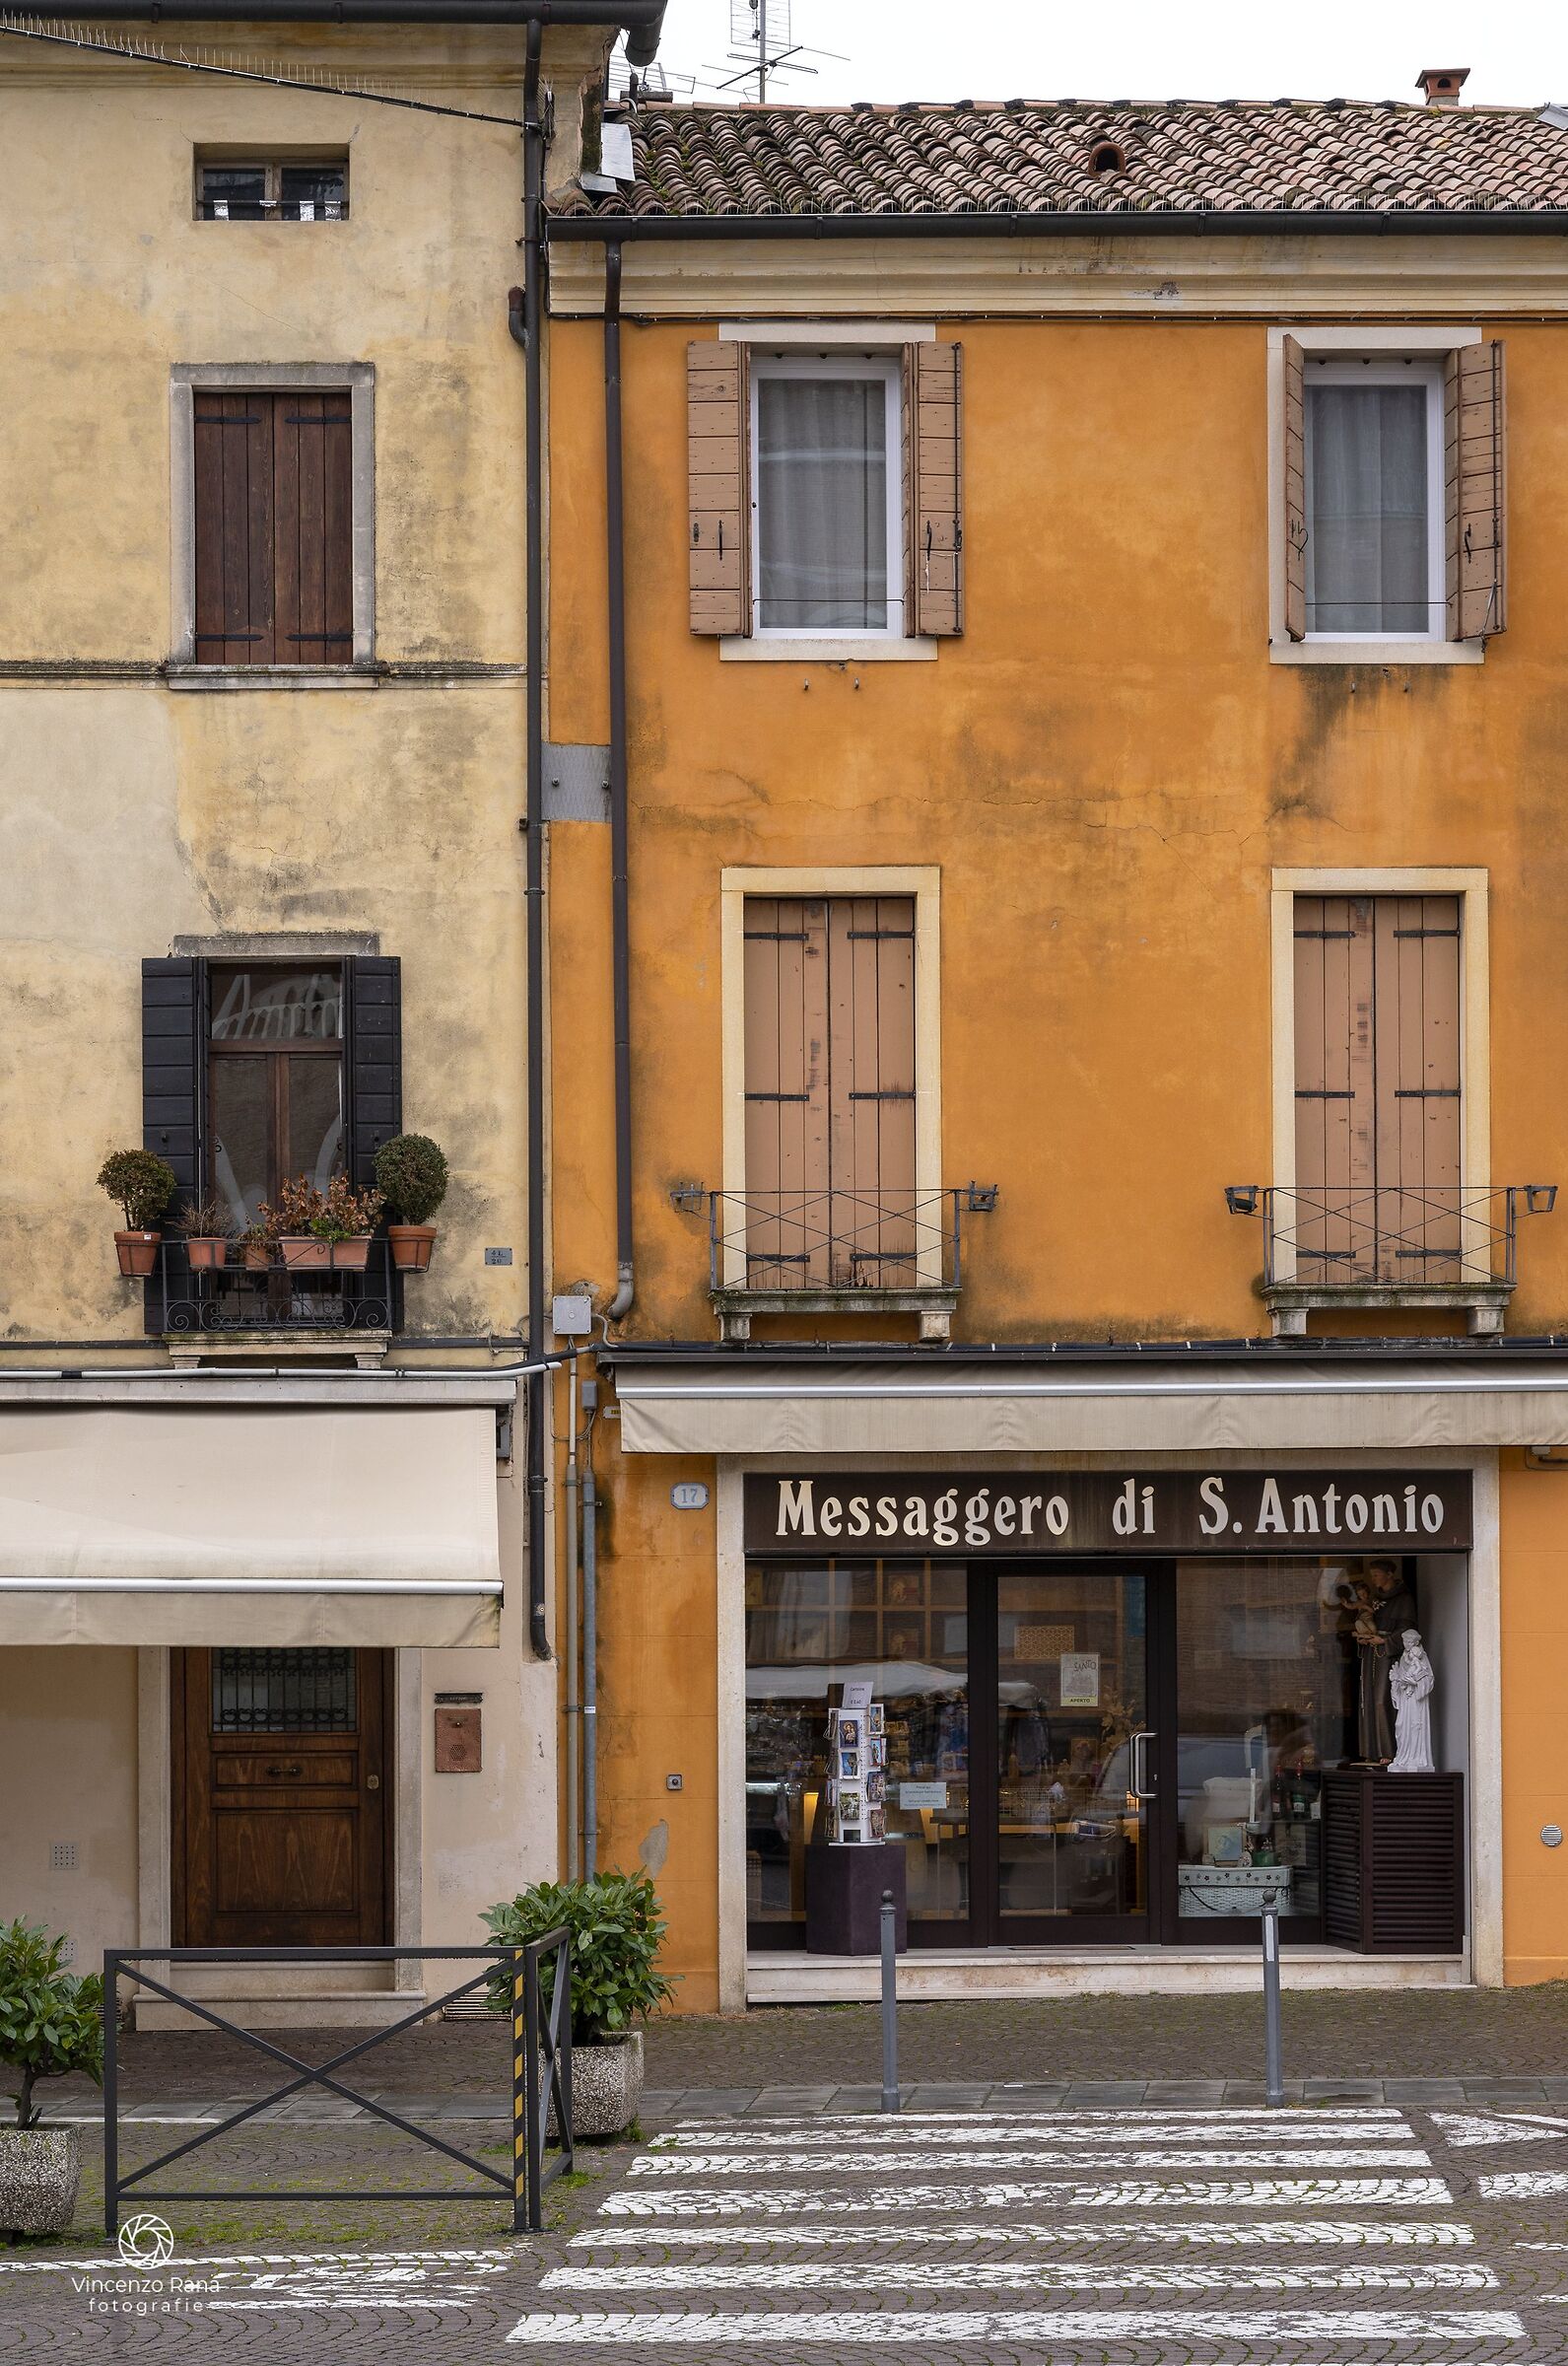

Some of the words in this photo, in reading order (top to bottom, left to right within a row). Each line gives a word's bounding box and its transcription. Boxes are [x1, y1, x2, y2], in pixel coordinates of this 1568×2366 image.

[681, 1489, 698, 1503] 17
[776, 1481, 1070, 1547] Messaggero
[1113, 1479, 1155, 1534] di
[1199, 1478, 1242, 1534] S.
[1255, 1479, 1443, 1533] Antonio
